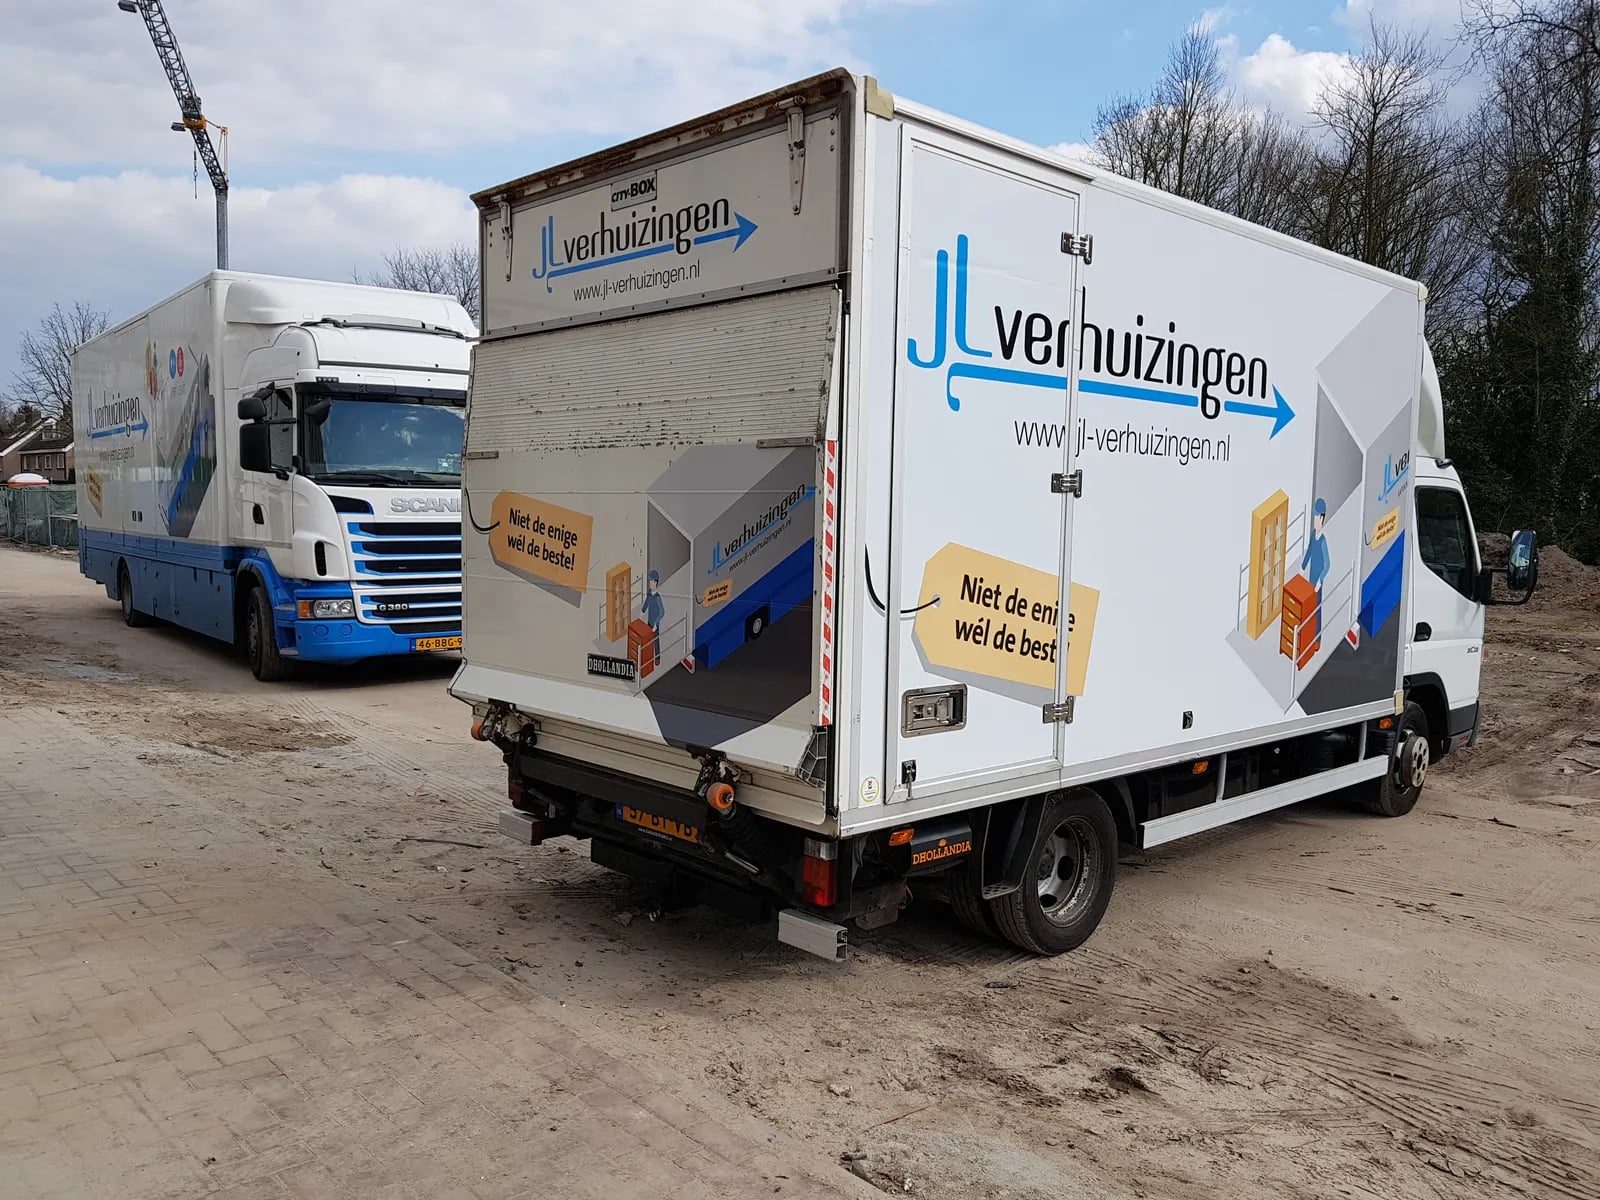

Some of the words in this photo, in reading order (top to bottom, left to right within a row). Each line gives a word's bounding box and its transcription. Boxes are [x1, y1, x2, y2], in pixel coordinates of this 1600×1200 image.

[573, 260, 700, 301] www.jl-verhuizingen.nl
[1014, 418, 1231, 466] wwwjl-verhuizingen.nl
[509, 507, 531, 531] Niet
[532, 515, 546, 536] de
[547, 524, 578, 549] enige
[507, 534, 526, 553] wél
[527, 538, 541, 558] de
[542, 542, 576, 571] beste!
[960, 574, 1002, 611] Niet
[1005, 587, 1028, 618] de
[1031, 600, 1076, 634] enie
[955, 617, 991, 646] wél
[993, 623, 1016, 653] de
[1019, 628, 1070, 664] best
[588, 658, 635, 677] DHOLLANDIA
[912, 841, 972, 865] DHOLLANDIA
